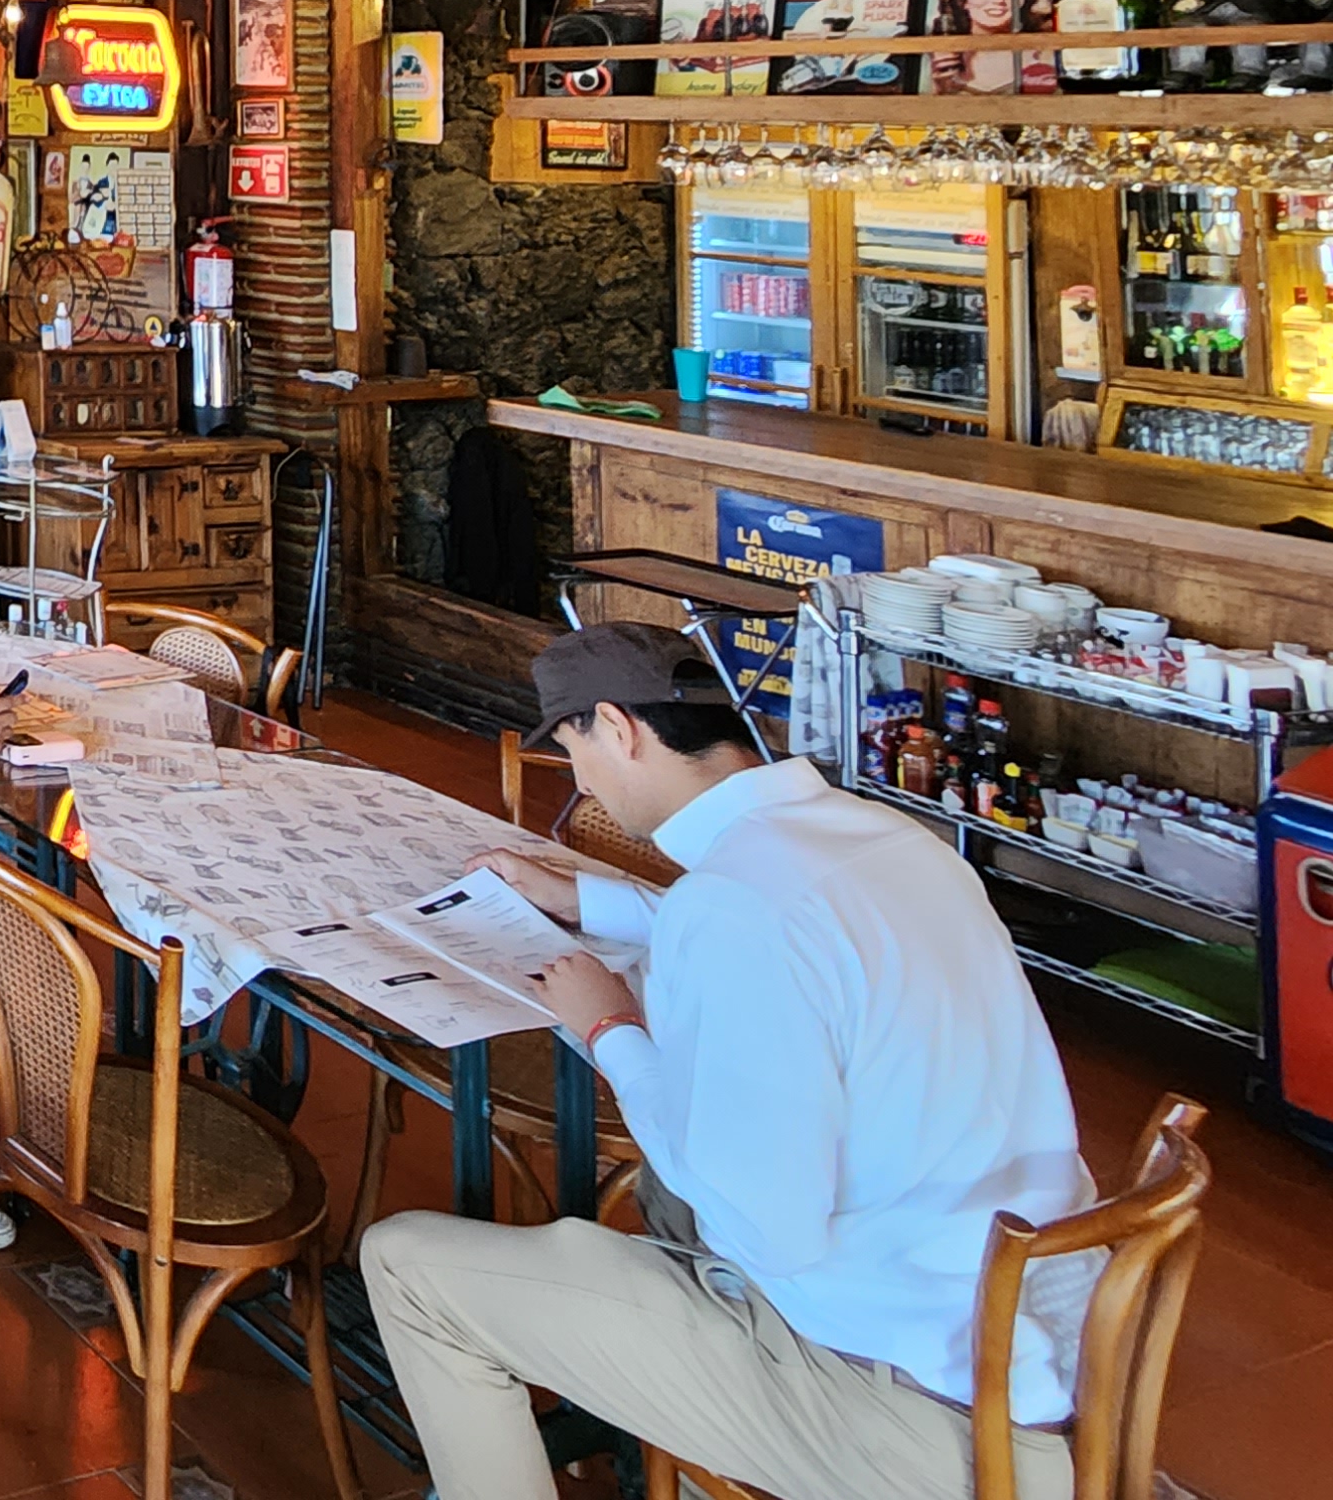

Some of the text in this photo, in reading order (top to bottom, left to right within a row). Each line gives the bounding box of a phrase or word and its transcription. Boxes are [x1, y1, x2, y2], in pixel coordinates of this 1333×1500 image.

[864, 0, 905, 11] SPARK
[863, 10, 906, 23] PLUGS
[686, 80, 767, 93] home oday!
[736, 526, 764, 546] LA
[745, 545, 831, 579] CERVEZA
[742, 616, 768, 636] EN
